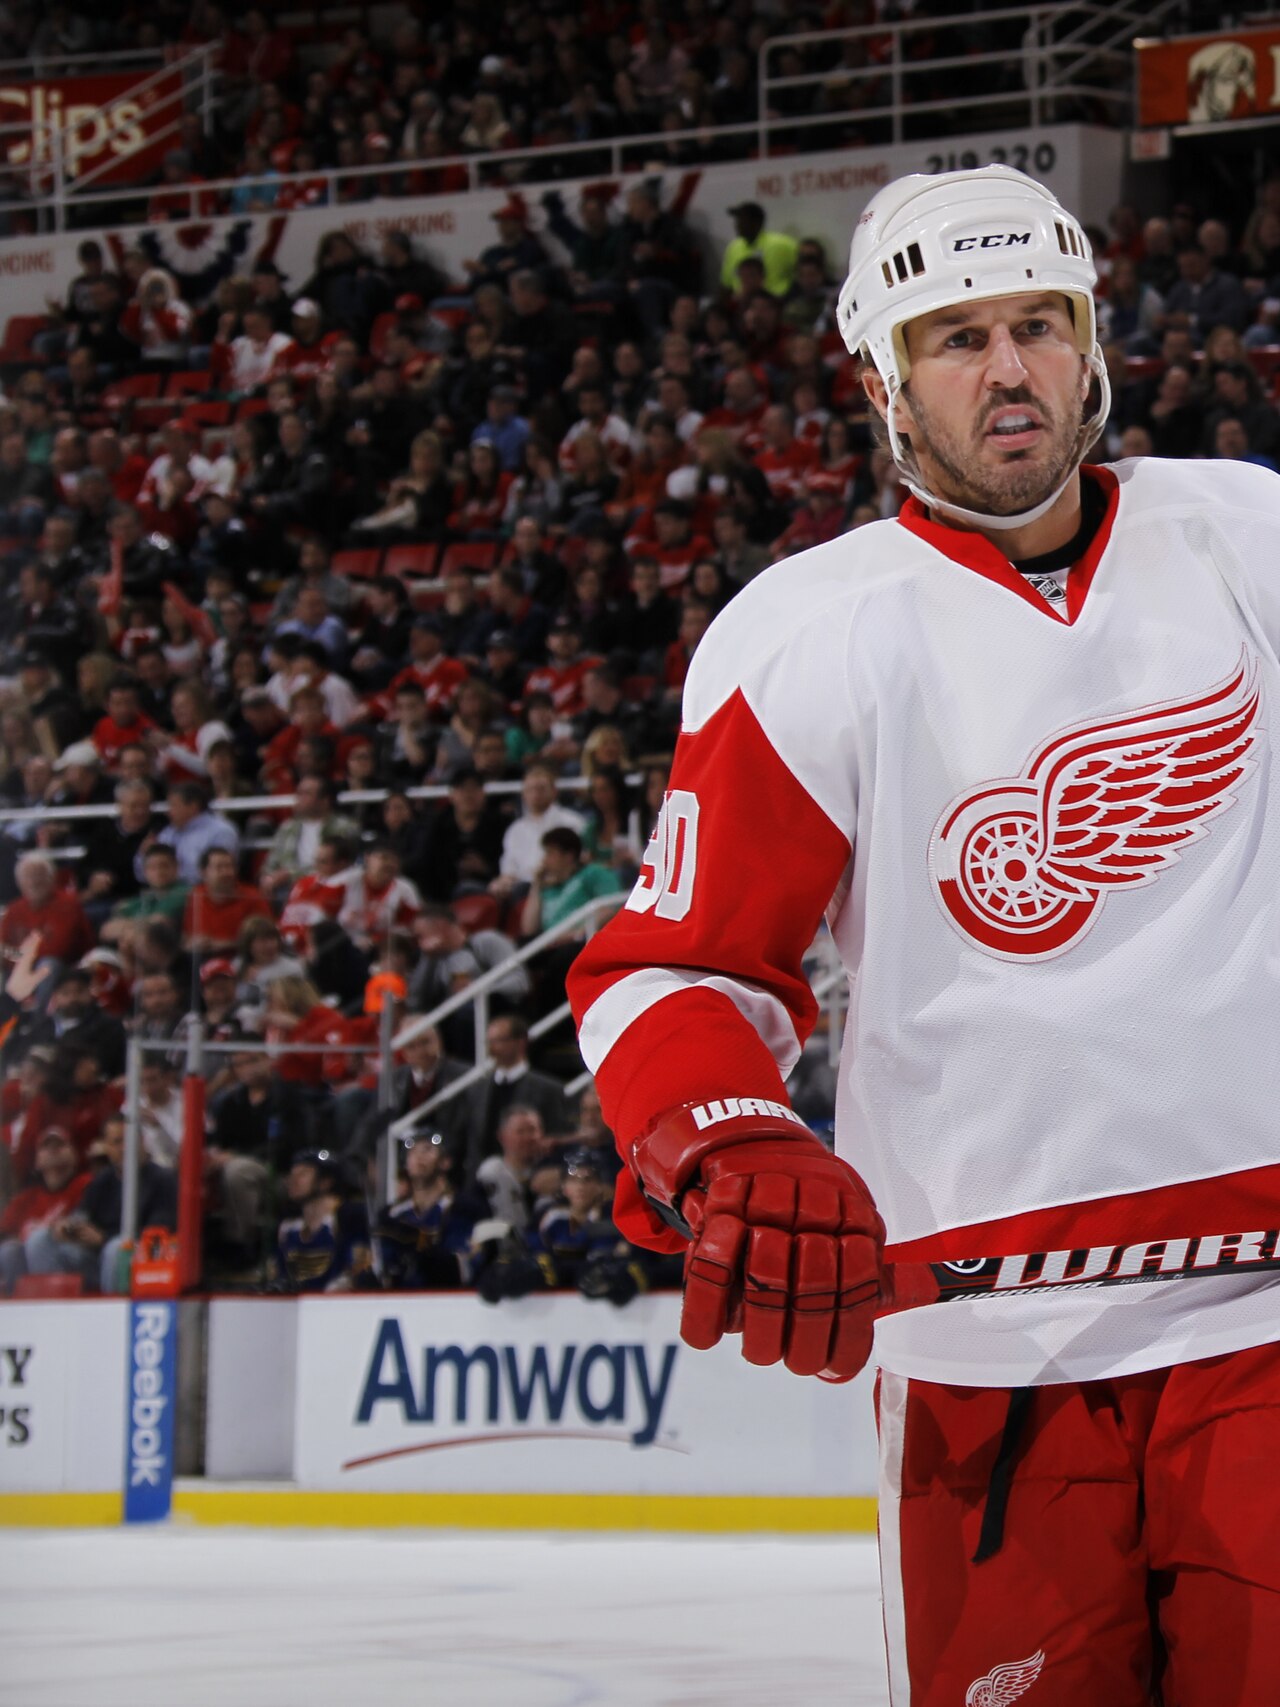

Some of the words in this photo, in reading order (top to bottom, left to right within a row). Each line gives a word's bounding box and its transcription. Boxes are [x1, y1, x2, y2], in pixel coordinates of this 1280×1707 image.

[953, 232, 1032, 252] CCM
[131, 1305, 171, 1487] Reebok
[355, 1317, 679, 1446] Amway
